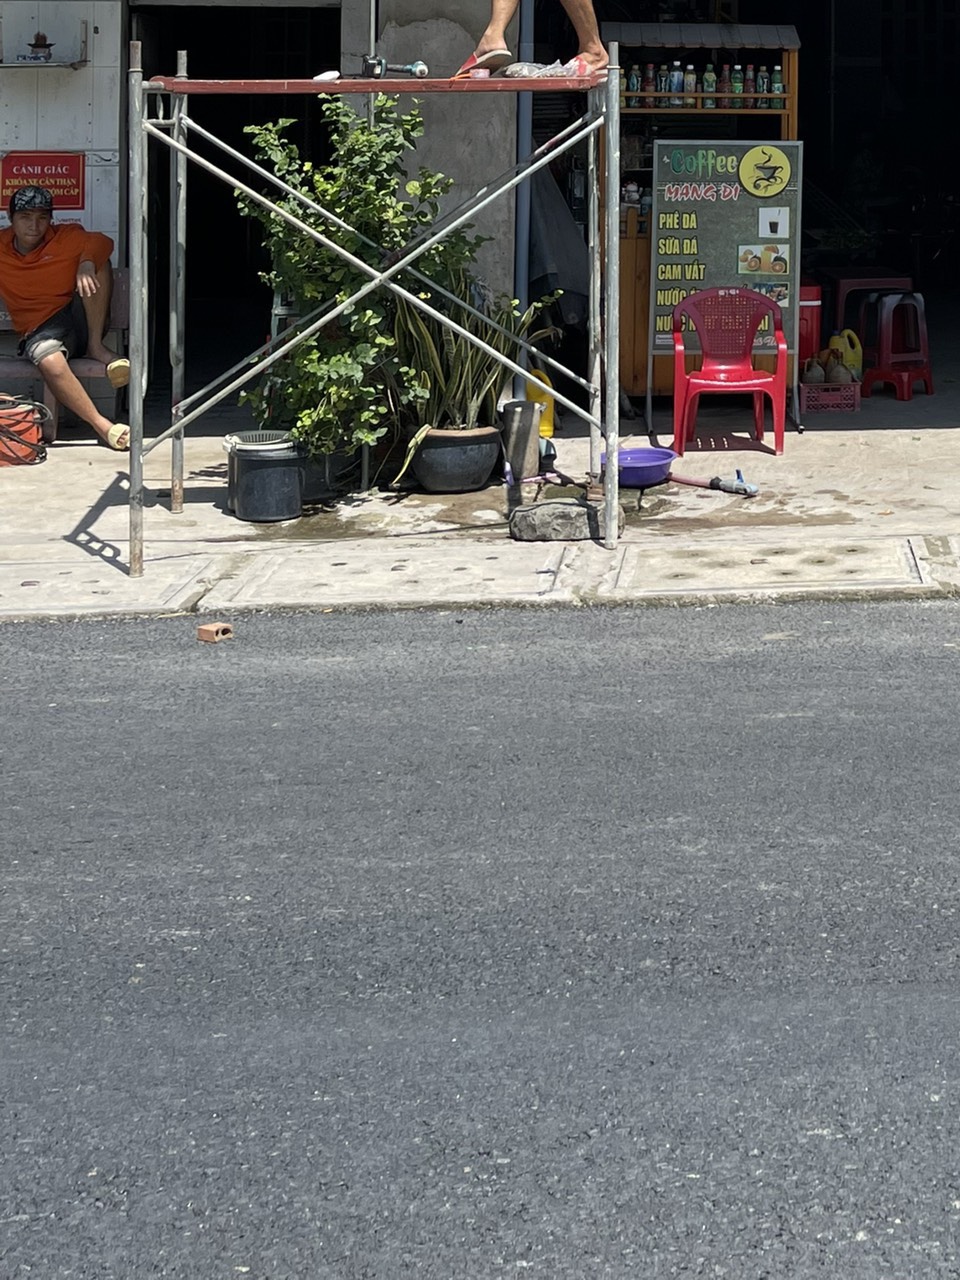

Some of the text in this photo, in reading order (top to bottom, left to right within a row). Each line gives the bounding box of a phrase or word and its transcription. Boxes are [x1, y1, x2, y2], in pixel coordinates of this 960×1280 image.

[12, 163, 70, 175] CẢNH GIÁC
[670, 148, 738, 179] Coffee
[664, 183, 717, 202] MANG
[659, 209, 698, 230] PHÊ ĐÁ
[658, 235, 698, 256] SỮA ĐÁ
[657, 263, 683, 281] CAM
